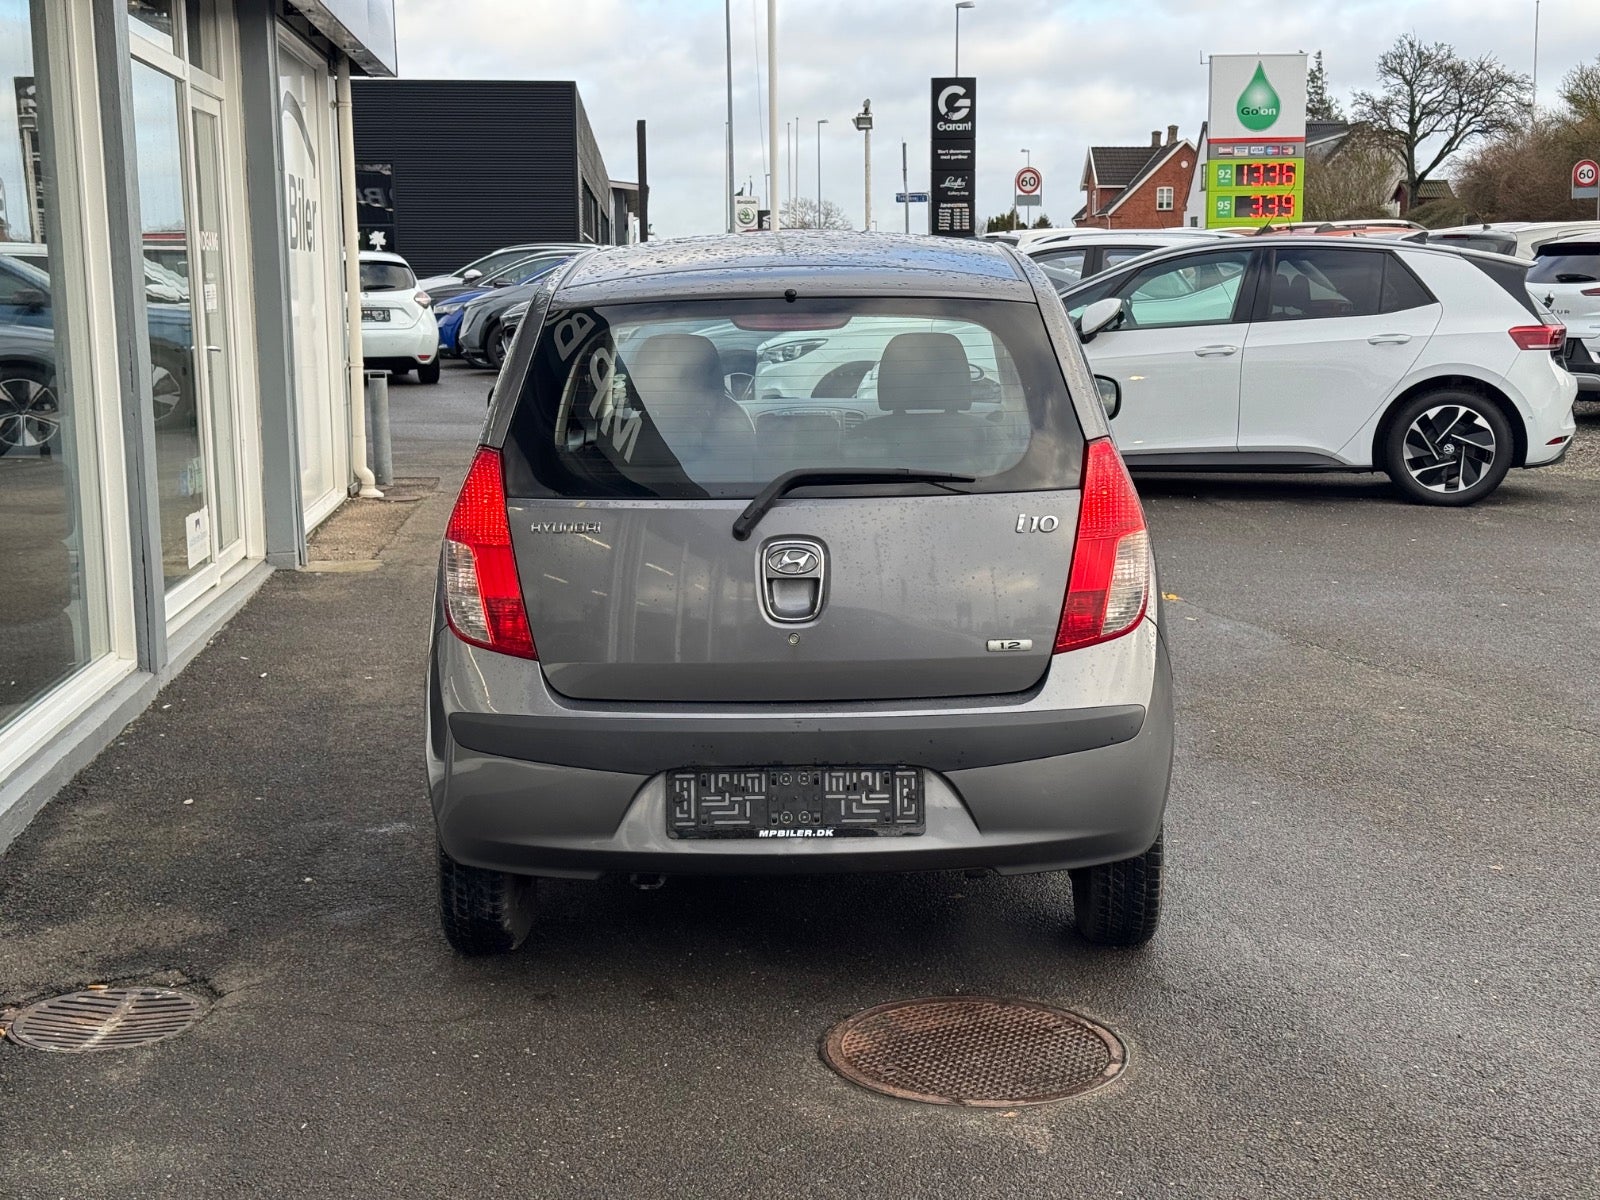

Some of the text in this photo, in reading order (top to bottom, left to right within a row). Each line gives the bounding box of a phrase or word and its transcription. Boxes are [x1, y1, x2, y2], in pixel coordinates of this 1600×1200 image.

[1241, 106, 1276, 116] Go'on
[937, 121, 972, 131] Garant
[1218, 169, 1231, 178] 92
[1579, 169, 1594, 179] 60
[1021, 176, 1036, 187] 60
[1217, 201, 1231, 210] 95
[288, 173, 317, 252] Biler
[530, 521, 601, 534] HYUNDAI
[758, 829, 835, 838] MPBILER.DK
